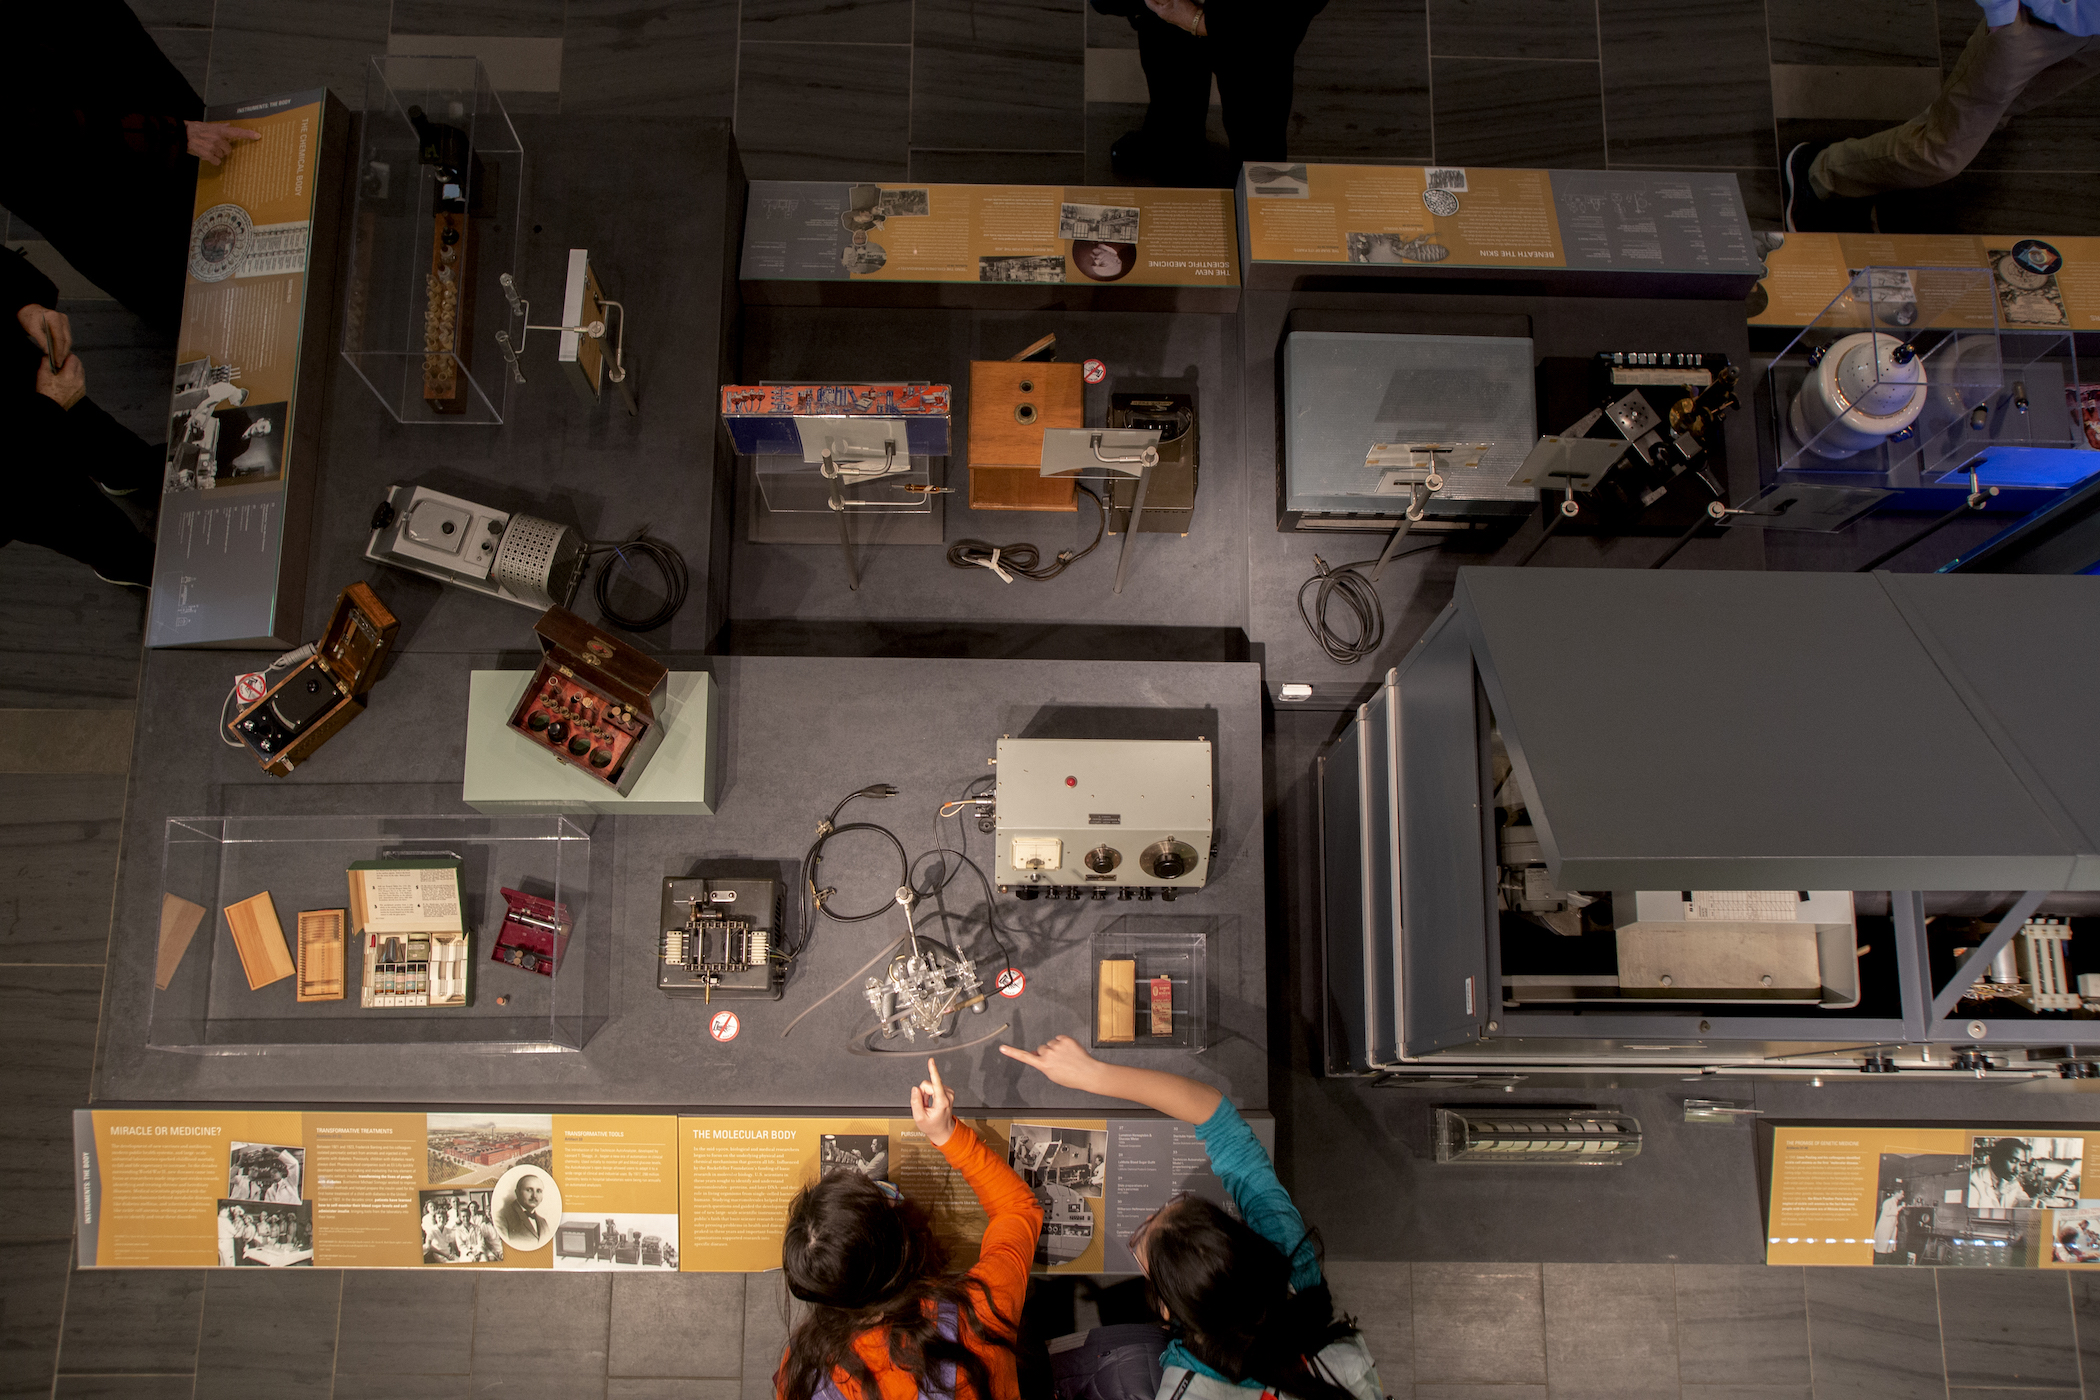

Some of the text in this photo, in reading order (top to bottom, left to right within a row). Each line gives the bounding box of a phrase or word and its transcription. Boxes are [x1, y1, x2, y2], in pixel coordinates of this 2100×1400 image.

[294, 118, 309, 196] THE CHEMICAL BODY
[110, 1126, 221, 1136] MIRACLE OR MEDICINE?
[693, 1130, 796, 1139] THE MOLECULAR BODY
